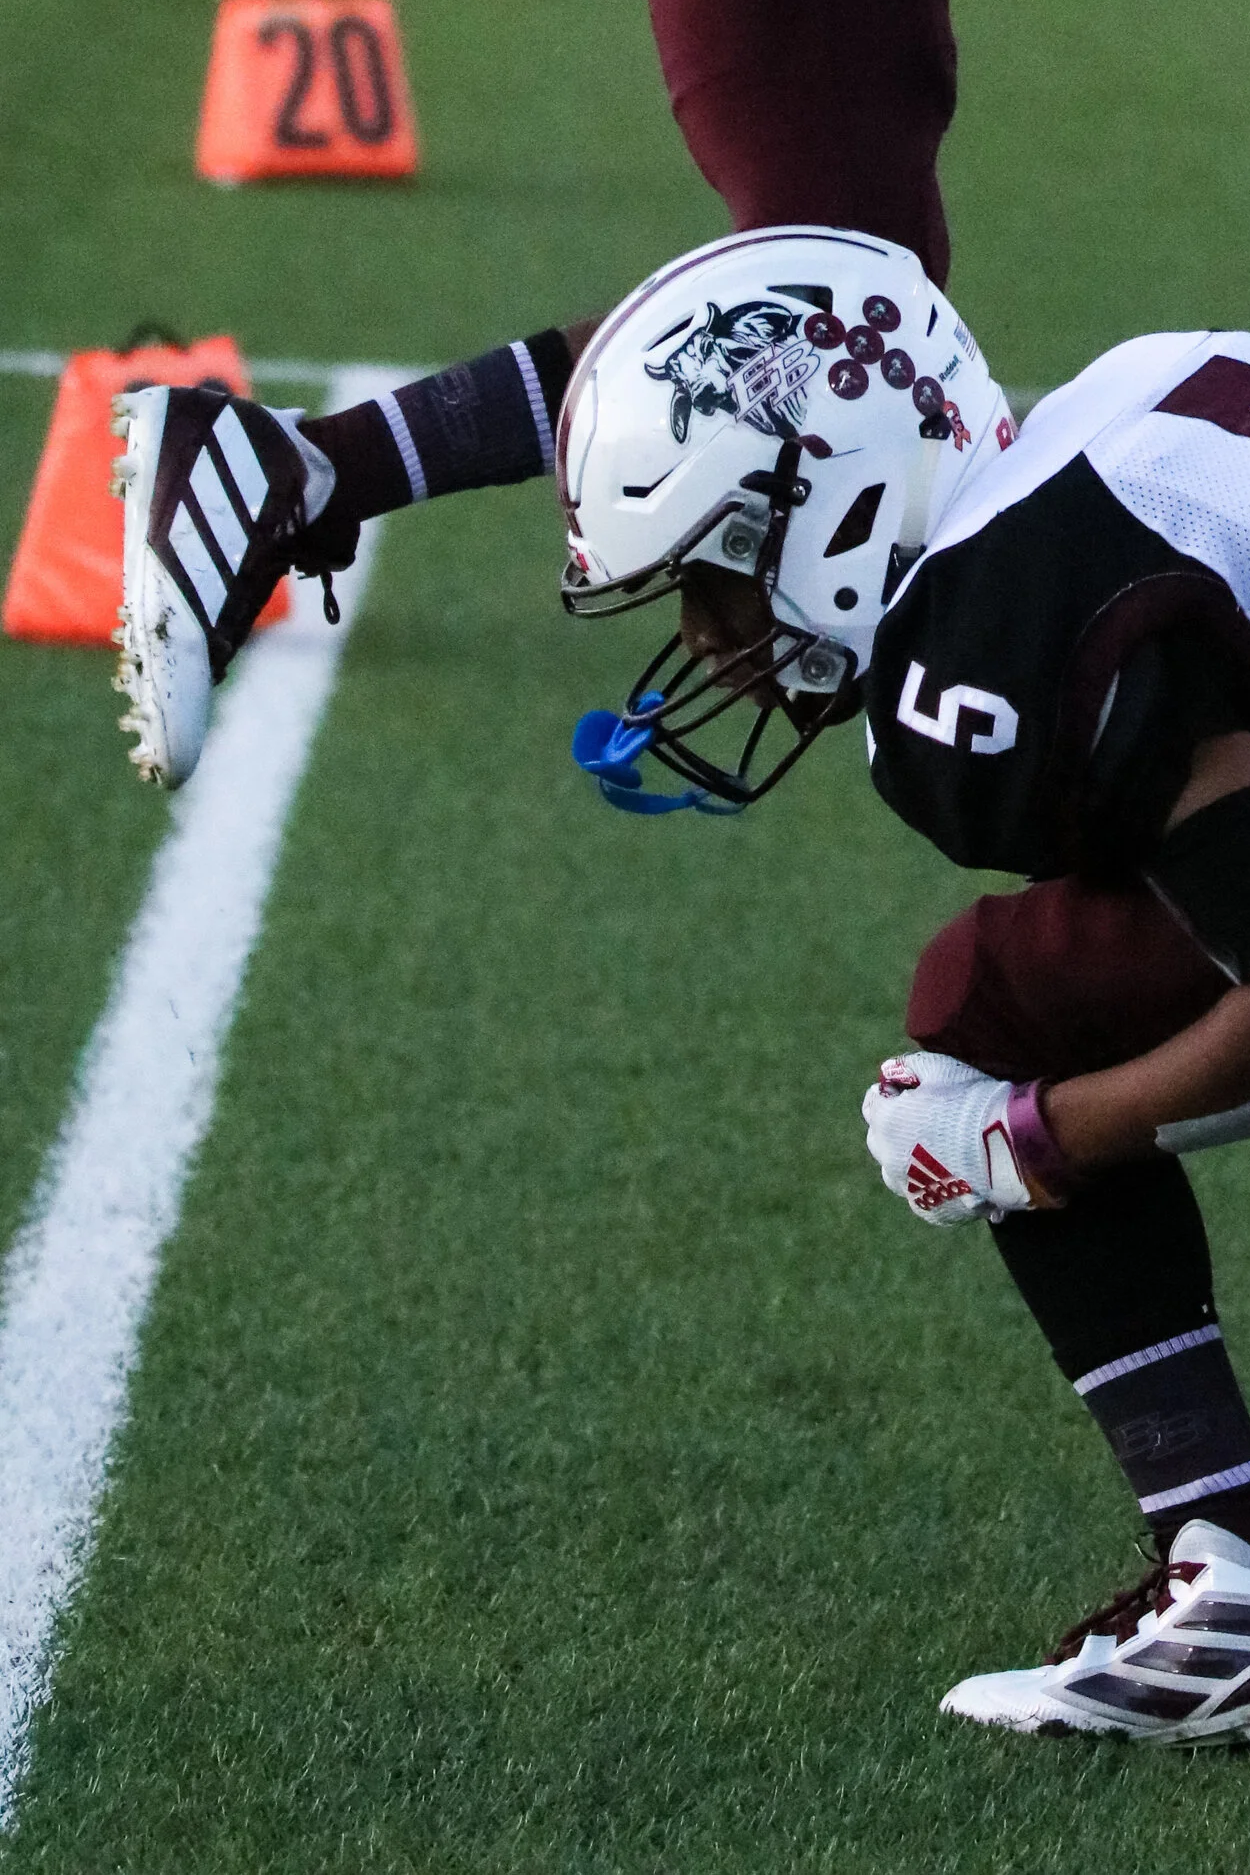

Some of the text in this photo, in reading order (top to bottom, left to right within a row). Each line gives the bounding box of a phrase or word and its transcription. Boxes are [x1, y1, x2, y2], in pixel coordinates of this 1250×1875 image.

[258, 14, 394, 149] 20
[725, 339, 821, 424] EB
[896, 660, 1019, 755] 5
[914, 1178, 972, 1212] adidas
